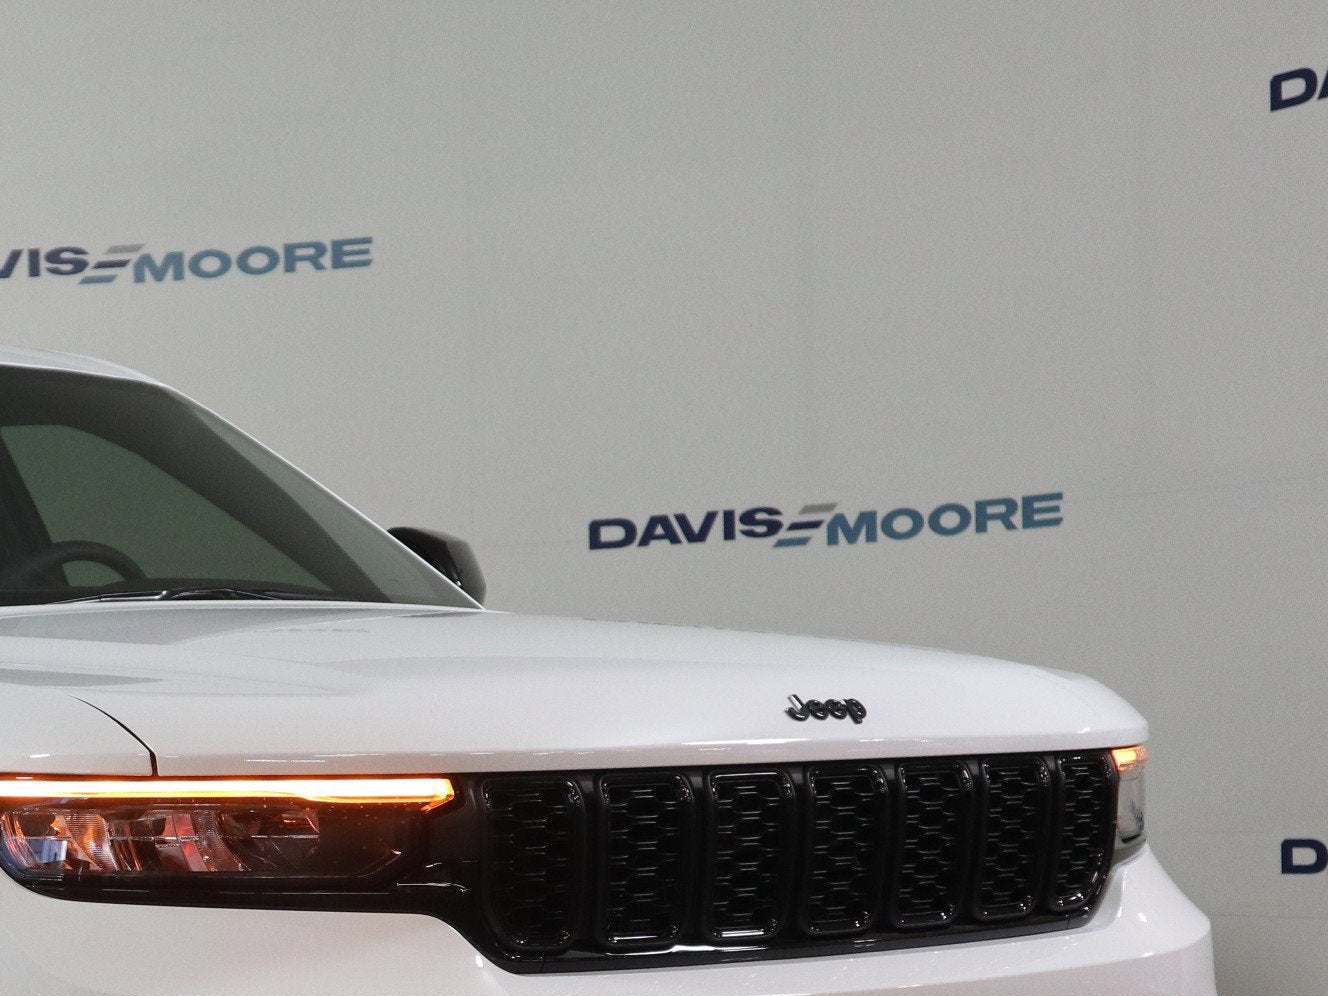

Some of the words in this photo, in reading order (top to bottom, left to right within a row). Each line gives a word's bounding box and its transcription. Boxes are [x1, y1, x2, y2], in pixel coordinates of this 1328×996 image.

[132, 236, 373, 284] MOORE
[588, 506, 784, 550] DAVIS
[826, 492, 1064, 546] MOORE
[784, 693, 867, 725] Jeep
